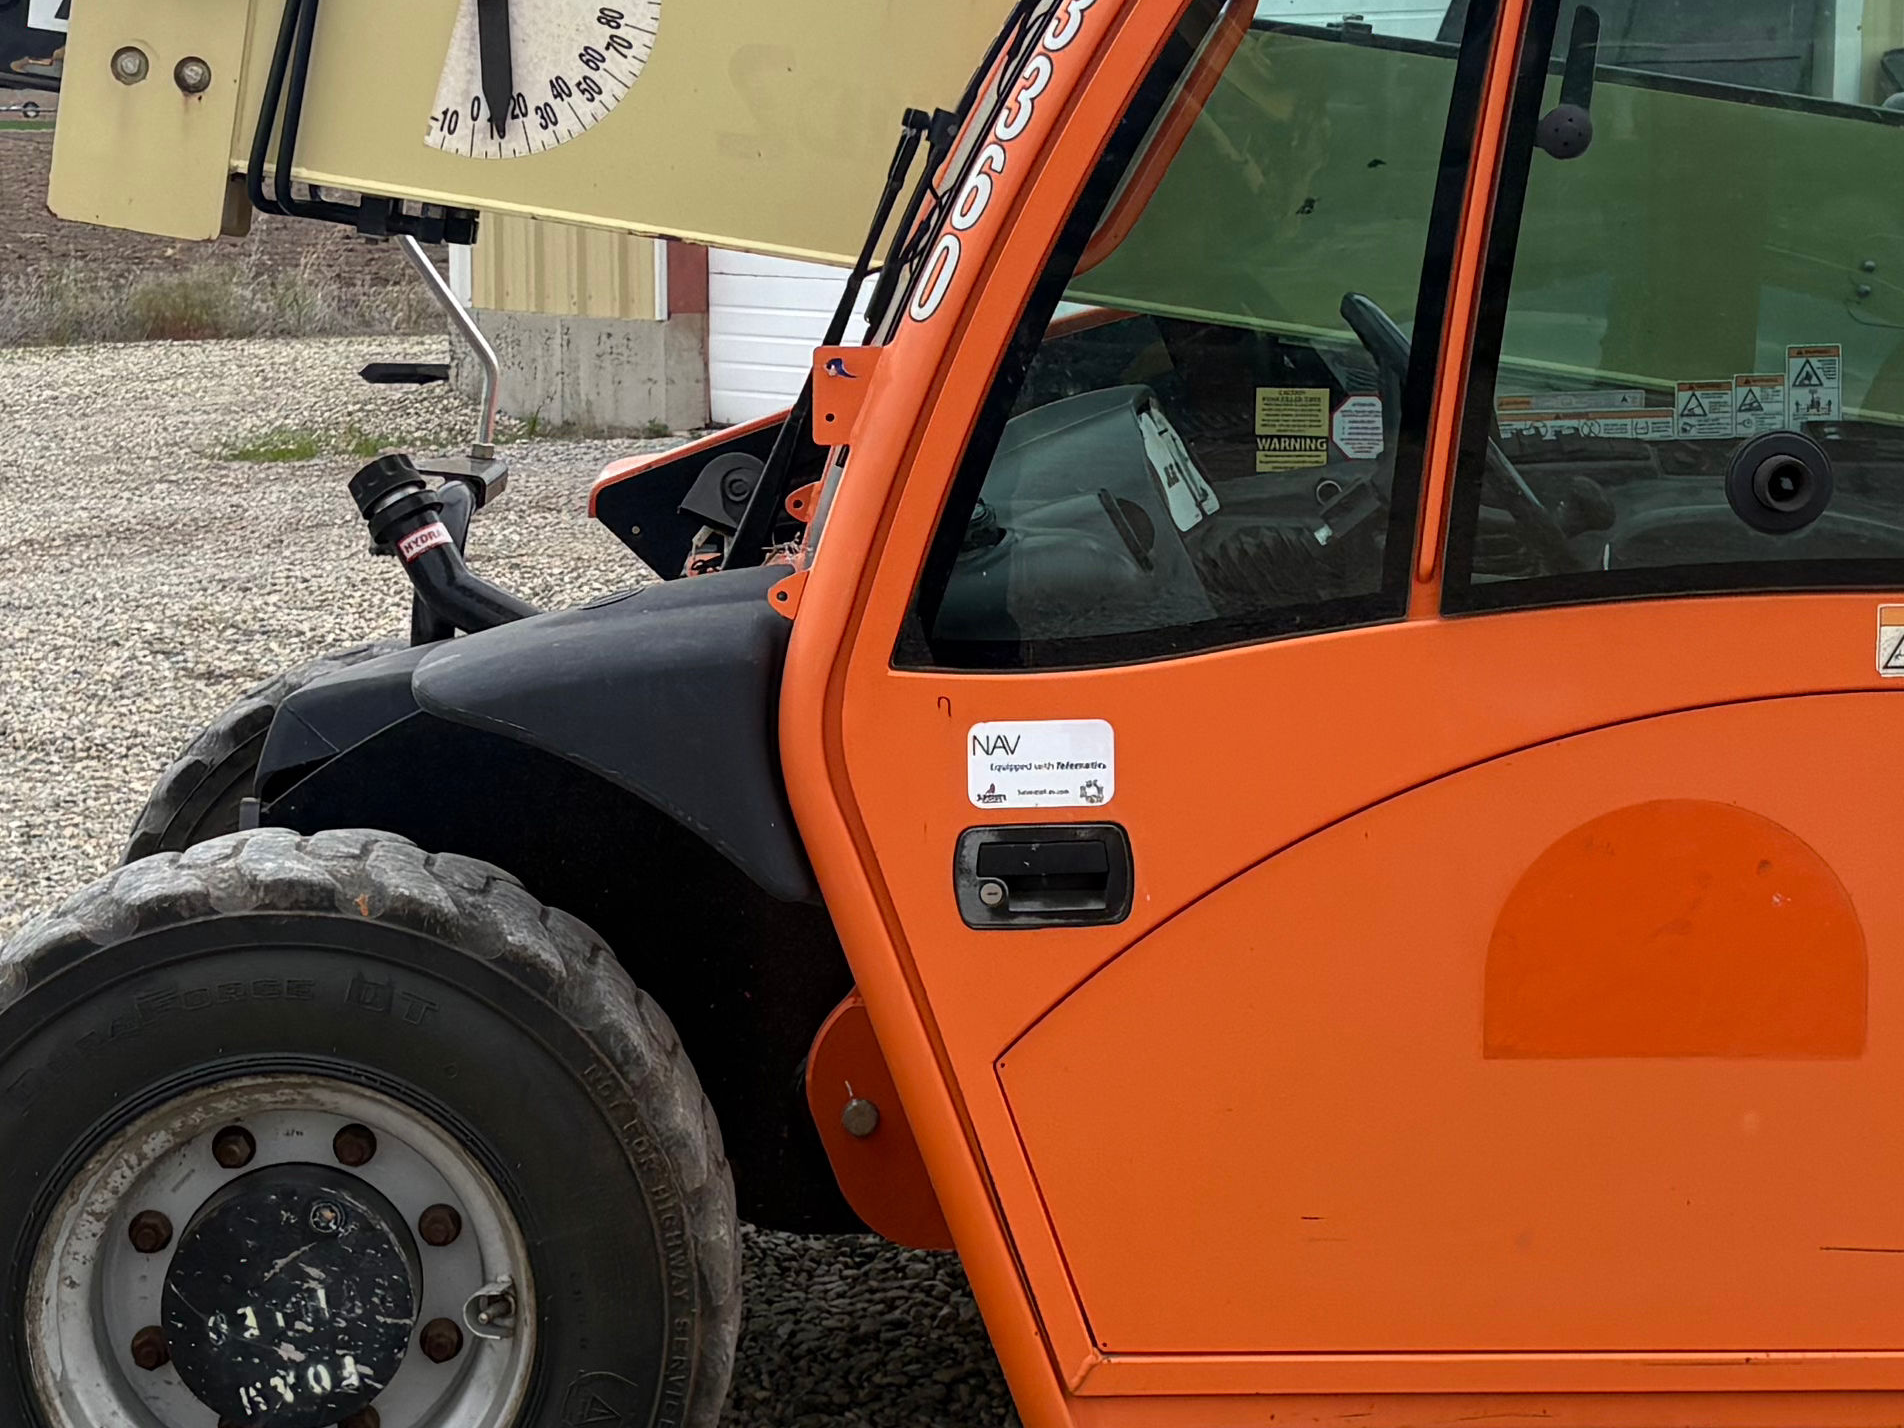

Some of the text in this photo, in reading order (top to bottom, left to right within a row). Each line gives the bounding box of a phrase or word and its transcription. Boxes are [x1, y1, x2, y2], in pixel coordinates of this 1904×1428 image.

[596, 7, 625, 30] 80
[578, 45, 606, 72] 60
[604, 34, 633, 59] 70
[549, 75, 573, 103] 40
[575, 75, 603, 103] 50
[471, 95, 481, 122] 0
[511, 92, 528, 120] 20
[534, 102, 559, 130] 30
[430, 108, 460, 135] -10
[1257, 437, 1327, 451] WARNING
[972, 734, 1021, 756] NAV
[990, 762, 1033, 773] Equipped
[652, 1184, 690, 1303] HIGHWAY
